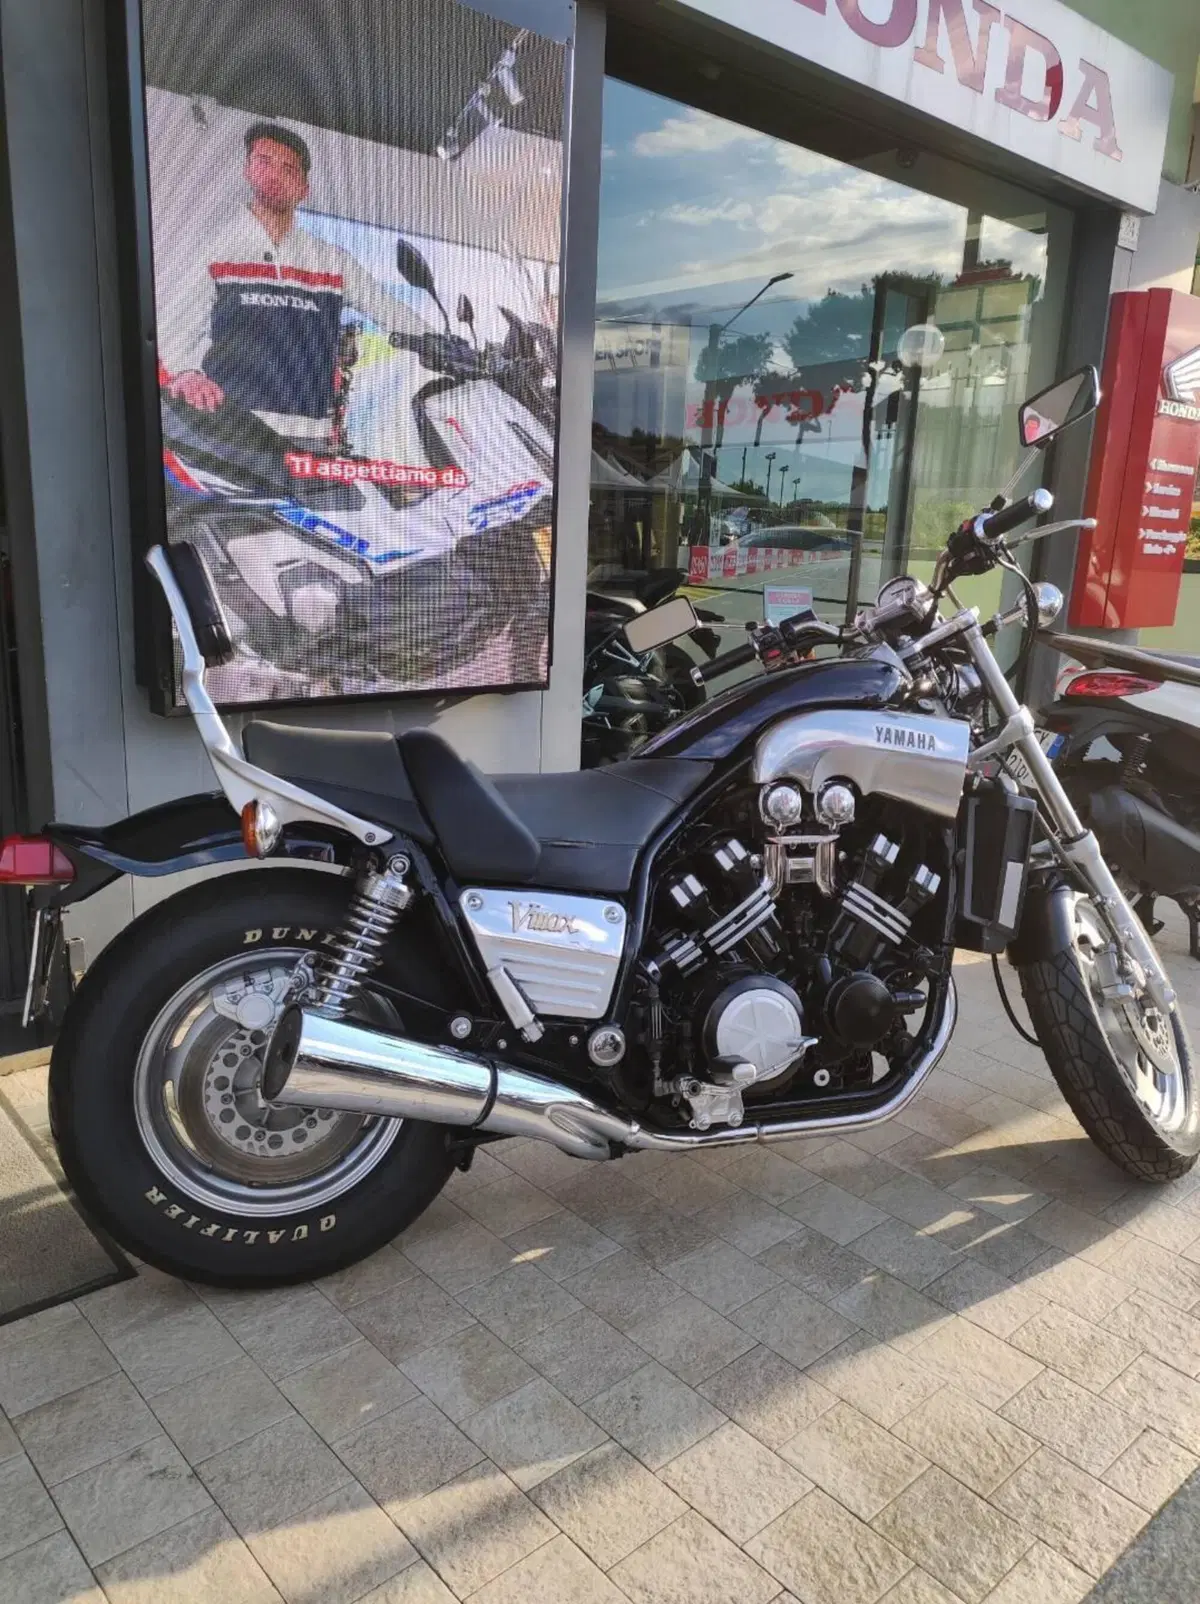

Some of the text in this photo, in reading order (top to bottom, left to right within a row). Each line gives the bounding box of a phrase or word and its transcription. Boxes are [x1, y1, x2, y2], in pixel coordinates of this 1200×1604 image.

[795, 0, 1123, 162] ONDA
[239, 293, 320, 312] HONDA
[317, 459, 437, 482] aspettiamo
[442, 468, 466, 485] da
[875, 725, 936, 751] YAMAHA
[243, 927, 353, 948] DUNL
[144, 1185, 337, 1245] QUALIFIER
